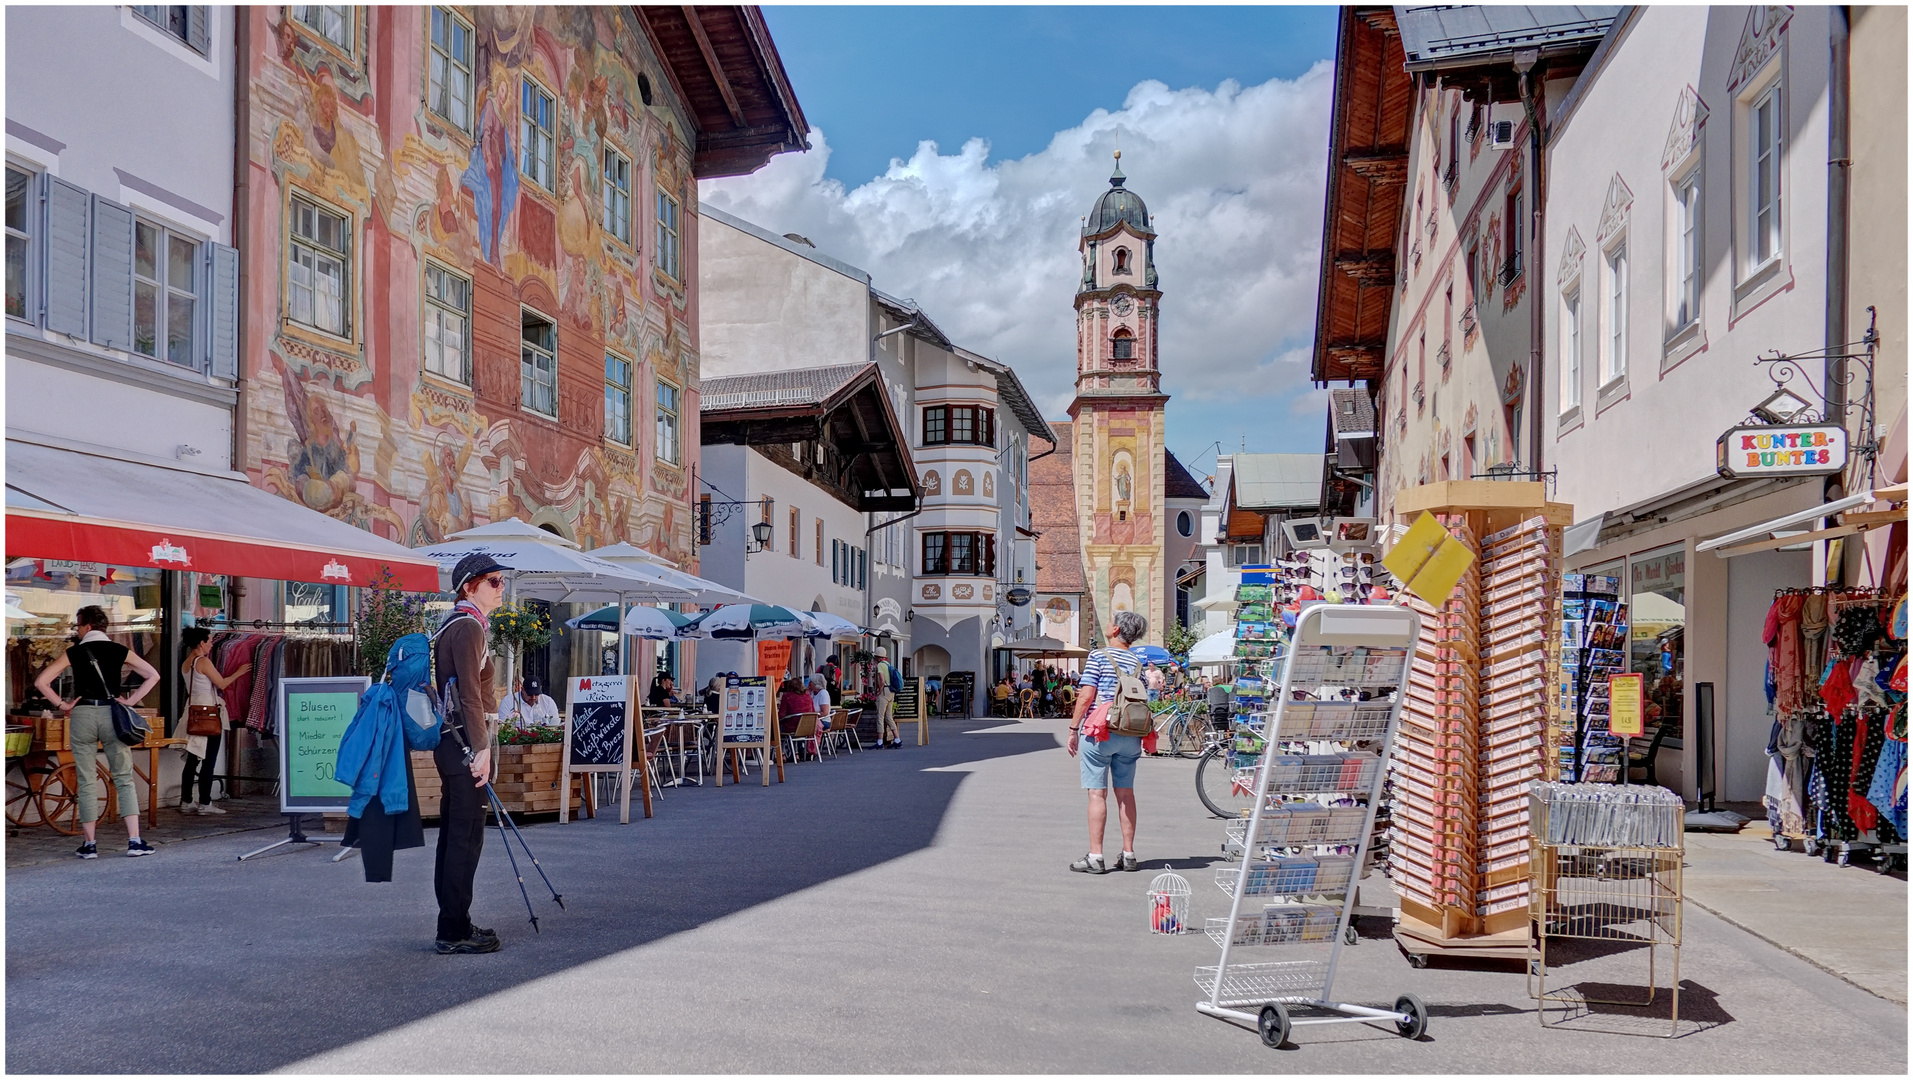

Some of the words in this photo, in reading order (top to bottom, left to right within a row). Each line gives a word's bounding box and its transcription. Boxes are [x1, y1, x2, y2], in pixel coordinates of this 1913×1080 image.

[1741, 432, 1835, 450] KUNTER-
[1746, 449, 1830, 467] BUNTES
[291, 582, 323, 607] Café
[579, 678, 623, 692] Metzgerei
[586, 691, 615, 702] Rieder
[301, 701, 337, 712] Blusen
[573, 707, 593, 728] Heute
[299, 730, 326, 740] Mieder
[576, 718, 598, 741] frische
[576, 714, 622, 758] Weißwürste
[1411, 727, 1430, 739] Chef
[298, 745, 337, 756] Schürzen
[592, 750, 604, 763] mit
[314, 762, 334, 781] 50
[1499, 829, 1515, 839] Falk
